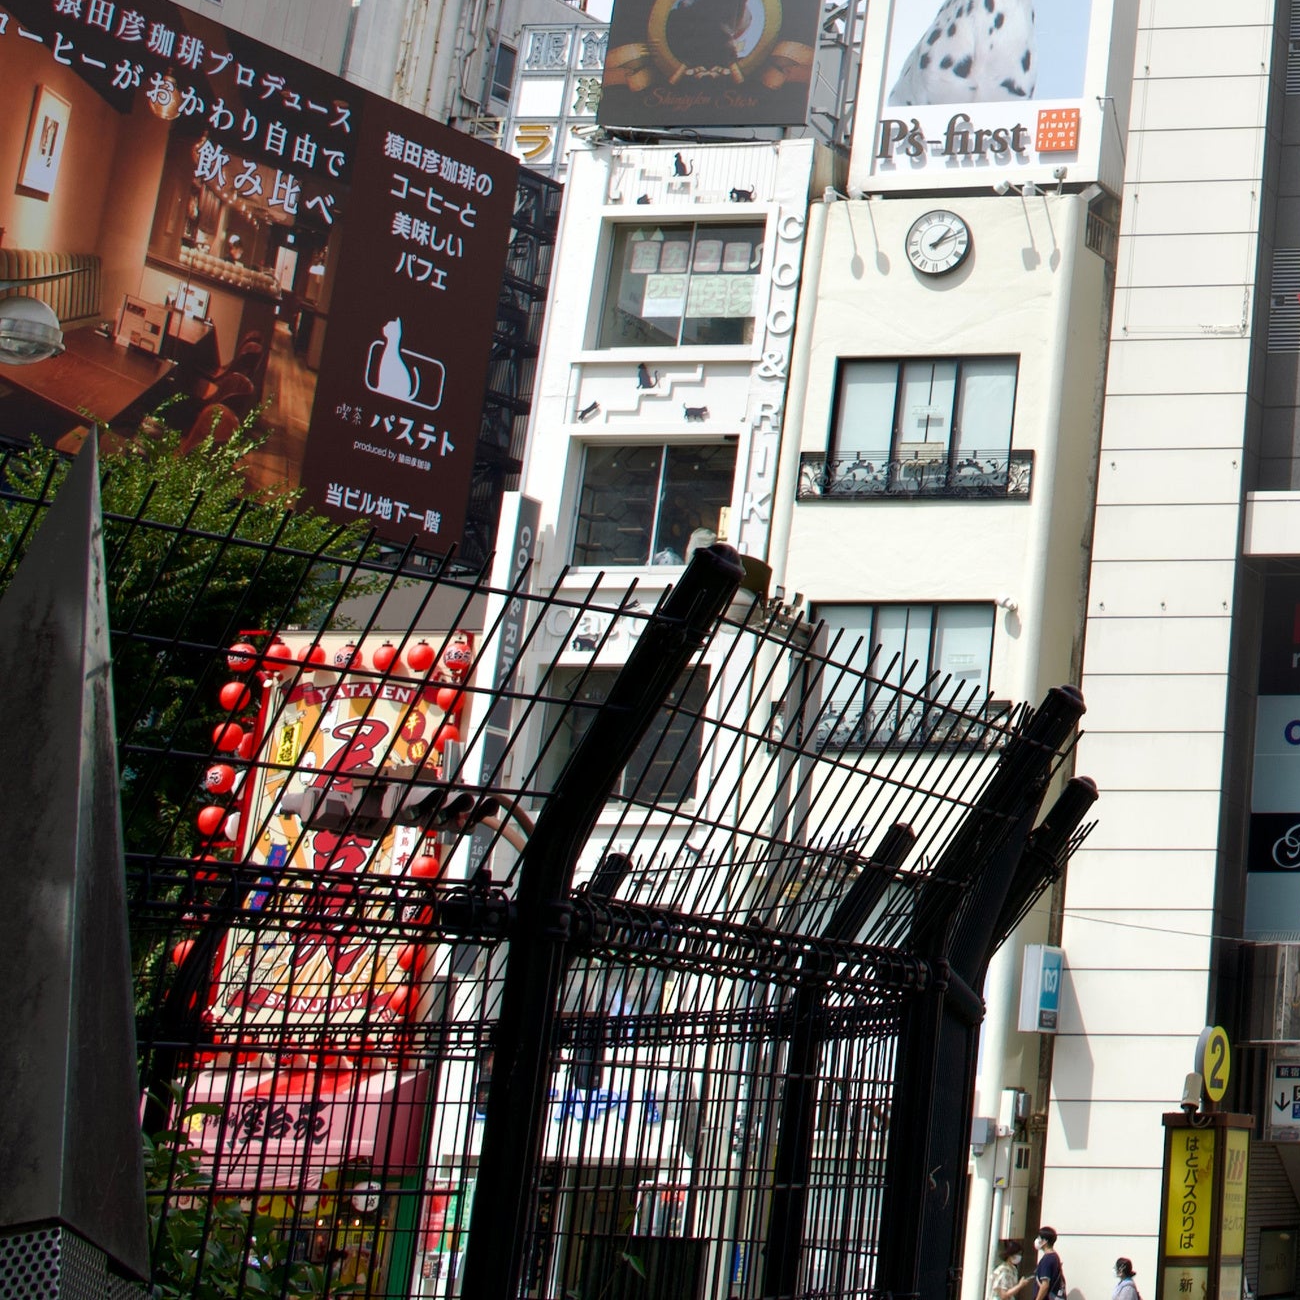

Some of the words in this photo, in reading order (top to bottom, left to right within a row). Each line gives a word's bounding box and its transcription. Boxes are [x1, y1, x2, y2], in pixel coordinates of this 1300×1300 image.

[876, 113, 1028, 159] P's-first
[1038, 130, 1075, 139] come
[1039, 120, 1076, 130] always
[1040, 111, 1077, 120] Pets
[384, 131, 493, 197] 猿田彦珈琲の
[1038, 139, 1075, 149] first
[194, 141, 336, 225] 飲み比べ
[390, 173, 478, 228] コーヒーと
[391, 211, 464, 258] 美味しい
[394, 252, 448, 291] パフェ
[767, 213, 804, 335] COO
[757, 350, 787, 381] &
[353, 440, 388, 457] produced
[388, 449, 397, 462] by
[739, 403, 780, 562] RIK
[325, 482, 441, 535] 当ビル地下一階
[1209, 1035, 1226, 1090] 2
[1179, 1136, 1202, 1250] はとバスのりば
